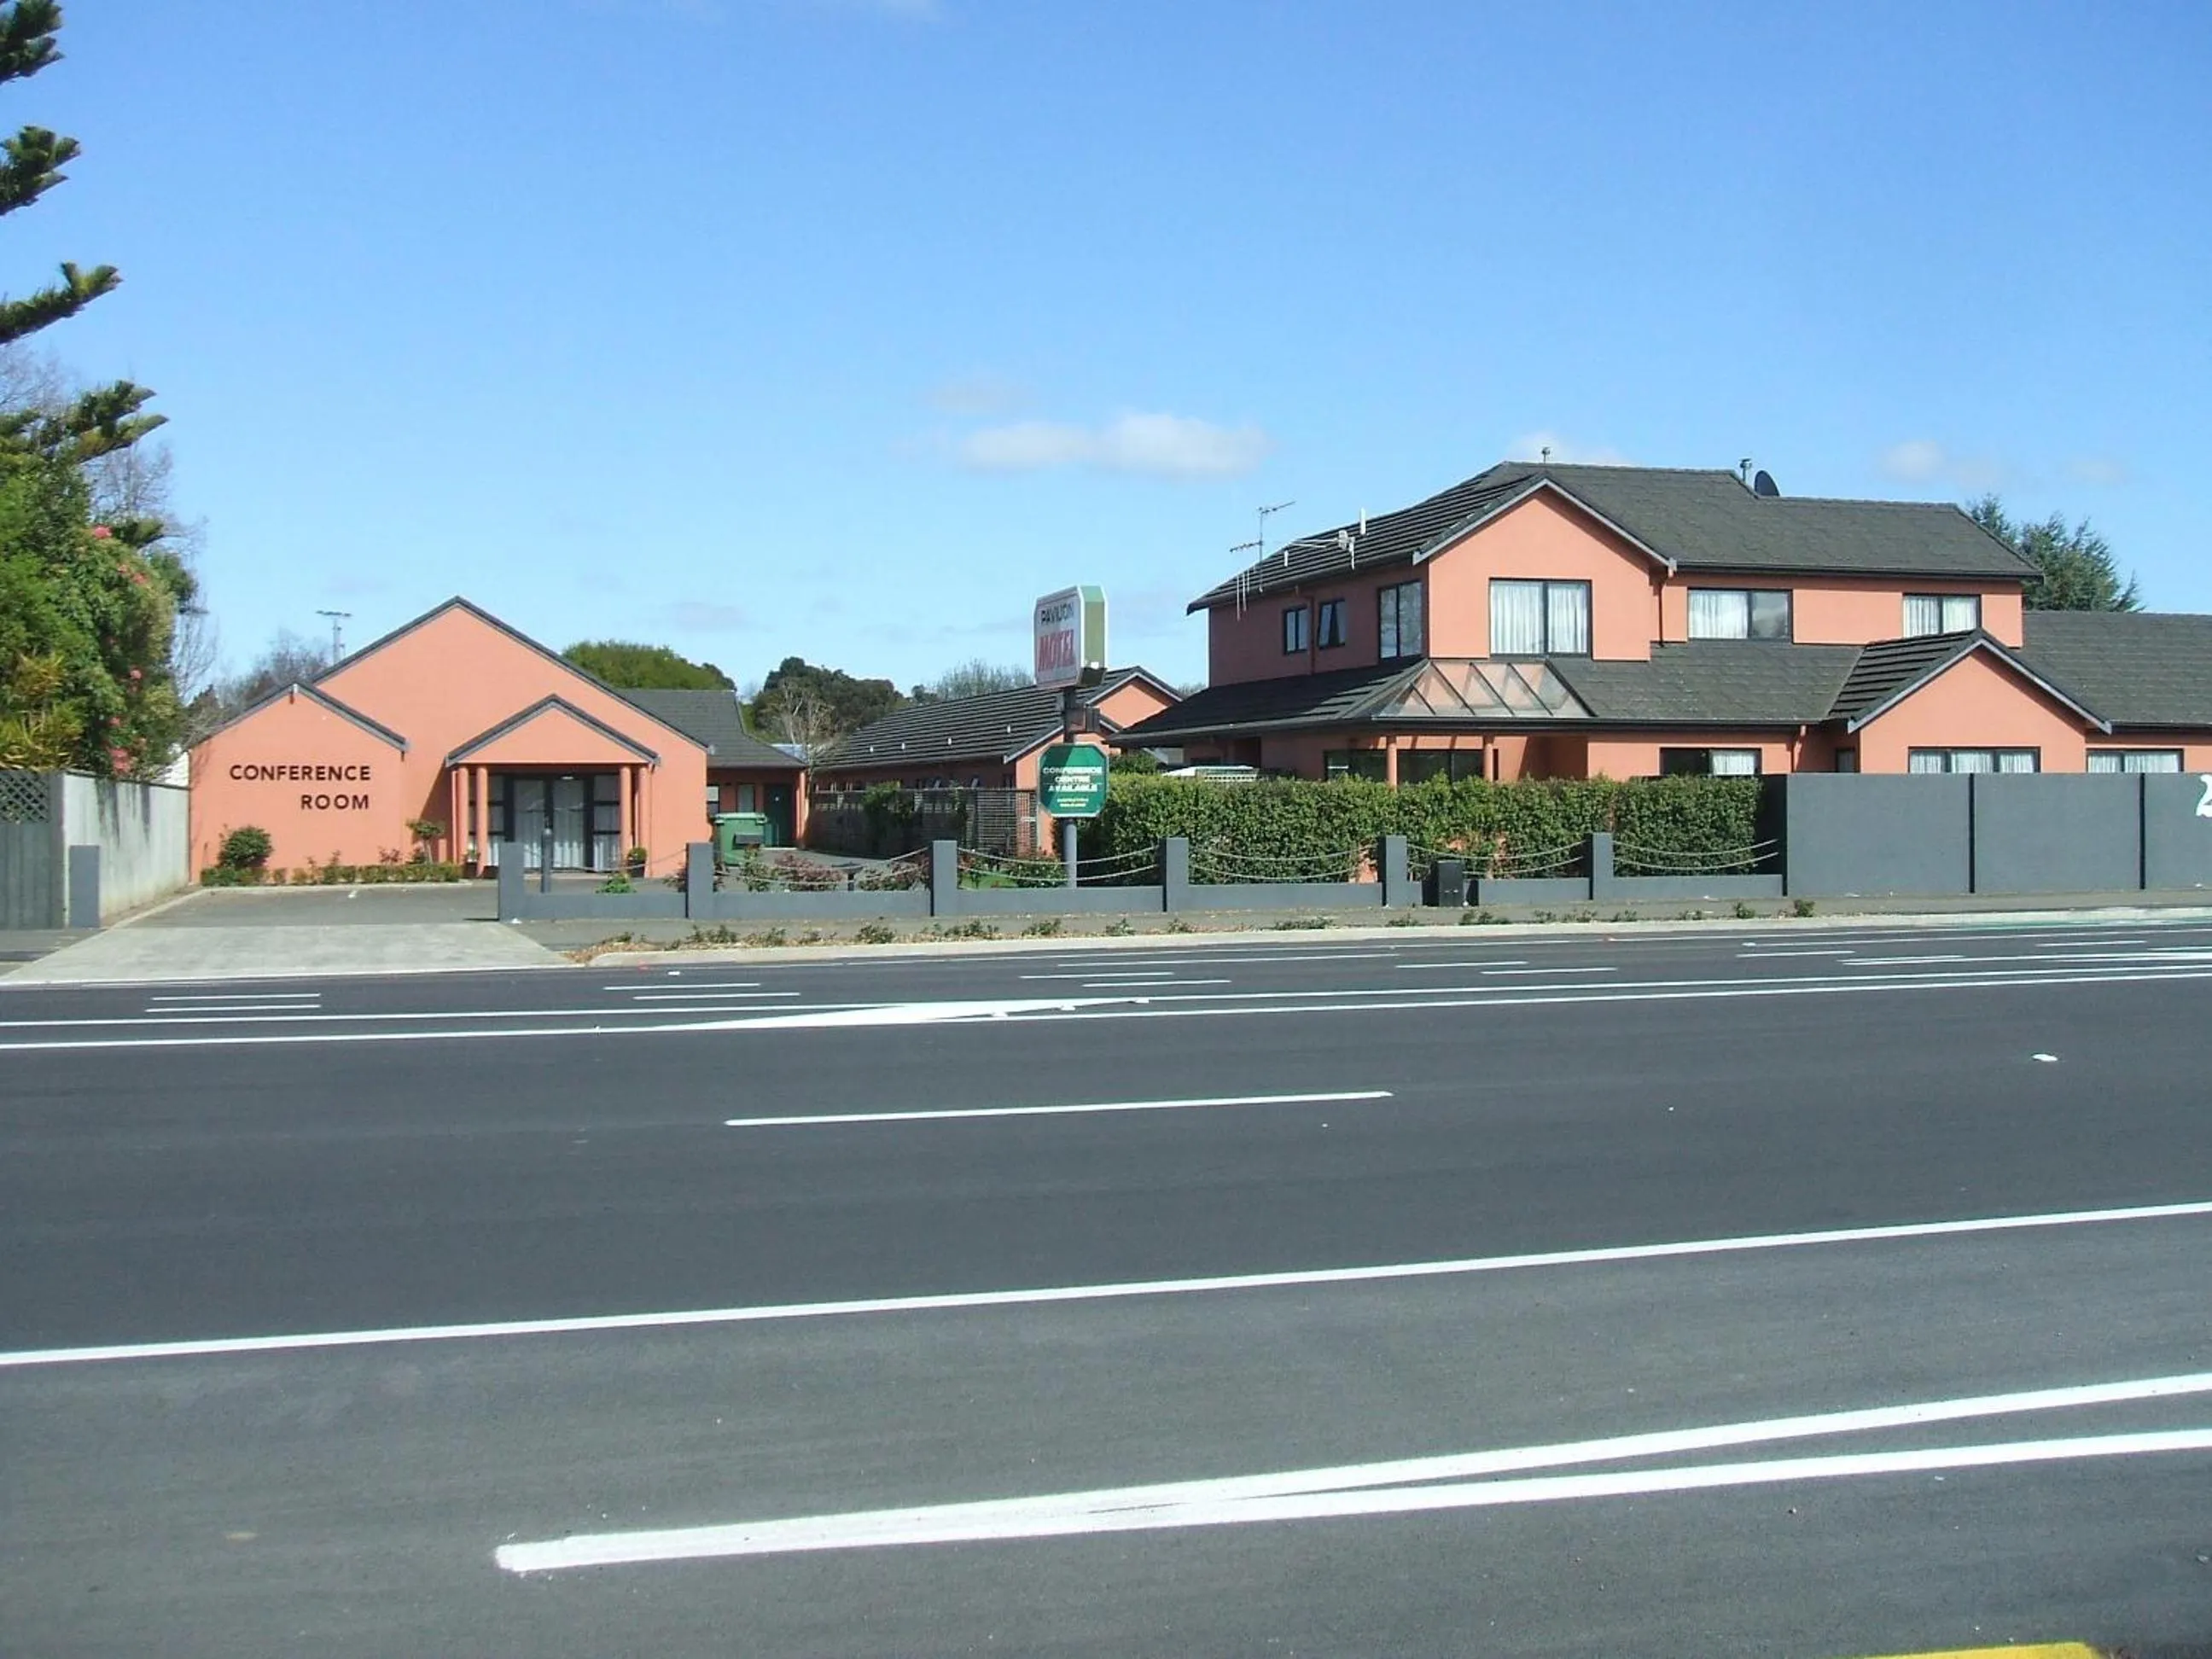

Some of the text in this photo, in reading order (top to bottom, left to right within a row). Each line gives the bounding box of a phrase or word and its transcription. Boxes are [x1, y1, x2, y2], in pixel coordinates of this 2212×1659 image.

[1038, 629, 1076, 672] MOTEL
[229, 765, 370, 781] CONFERENCE
[300, 795, 370, 810] ROOM
